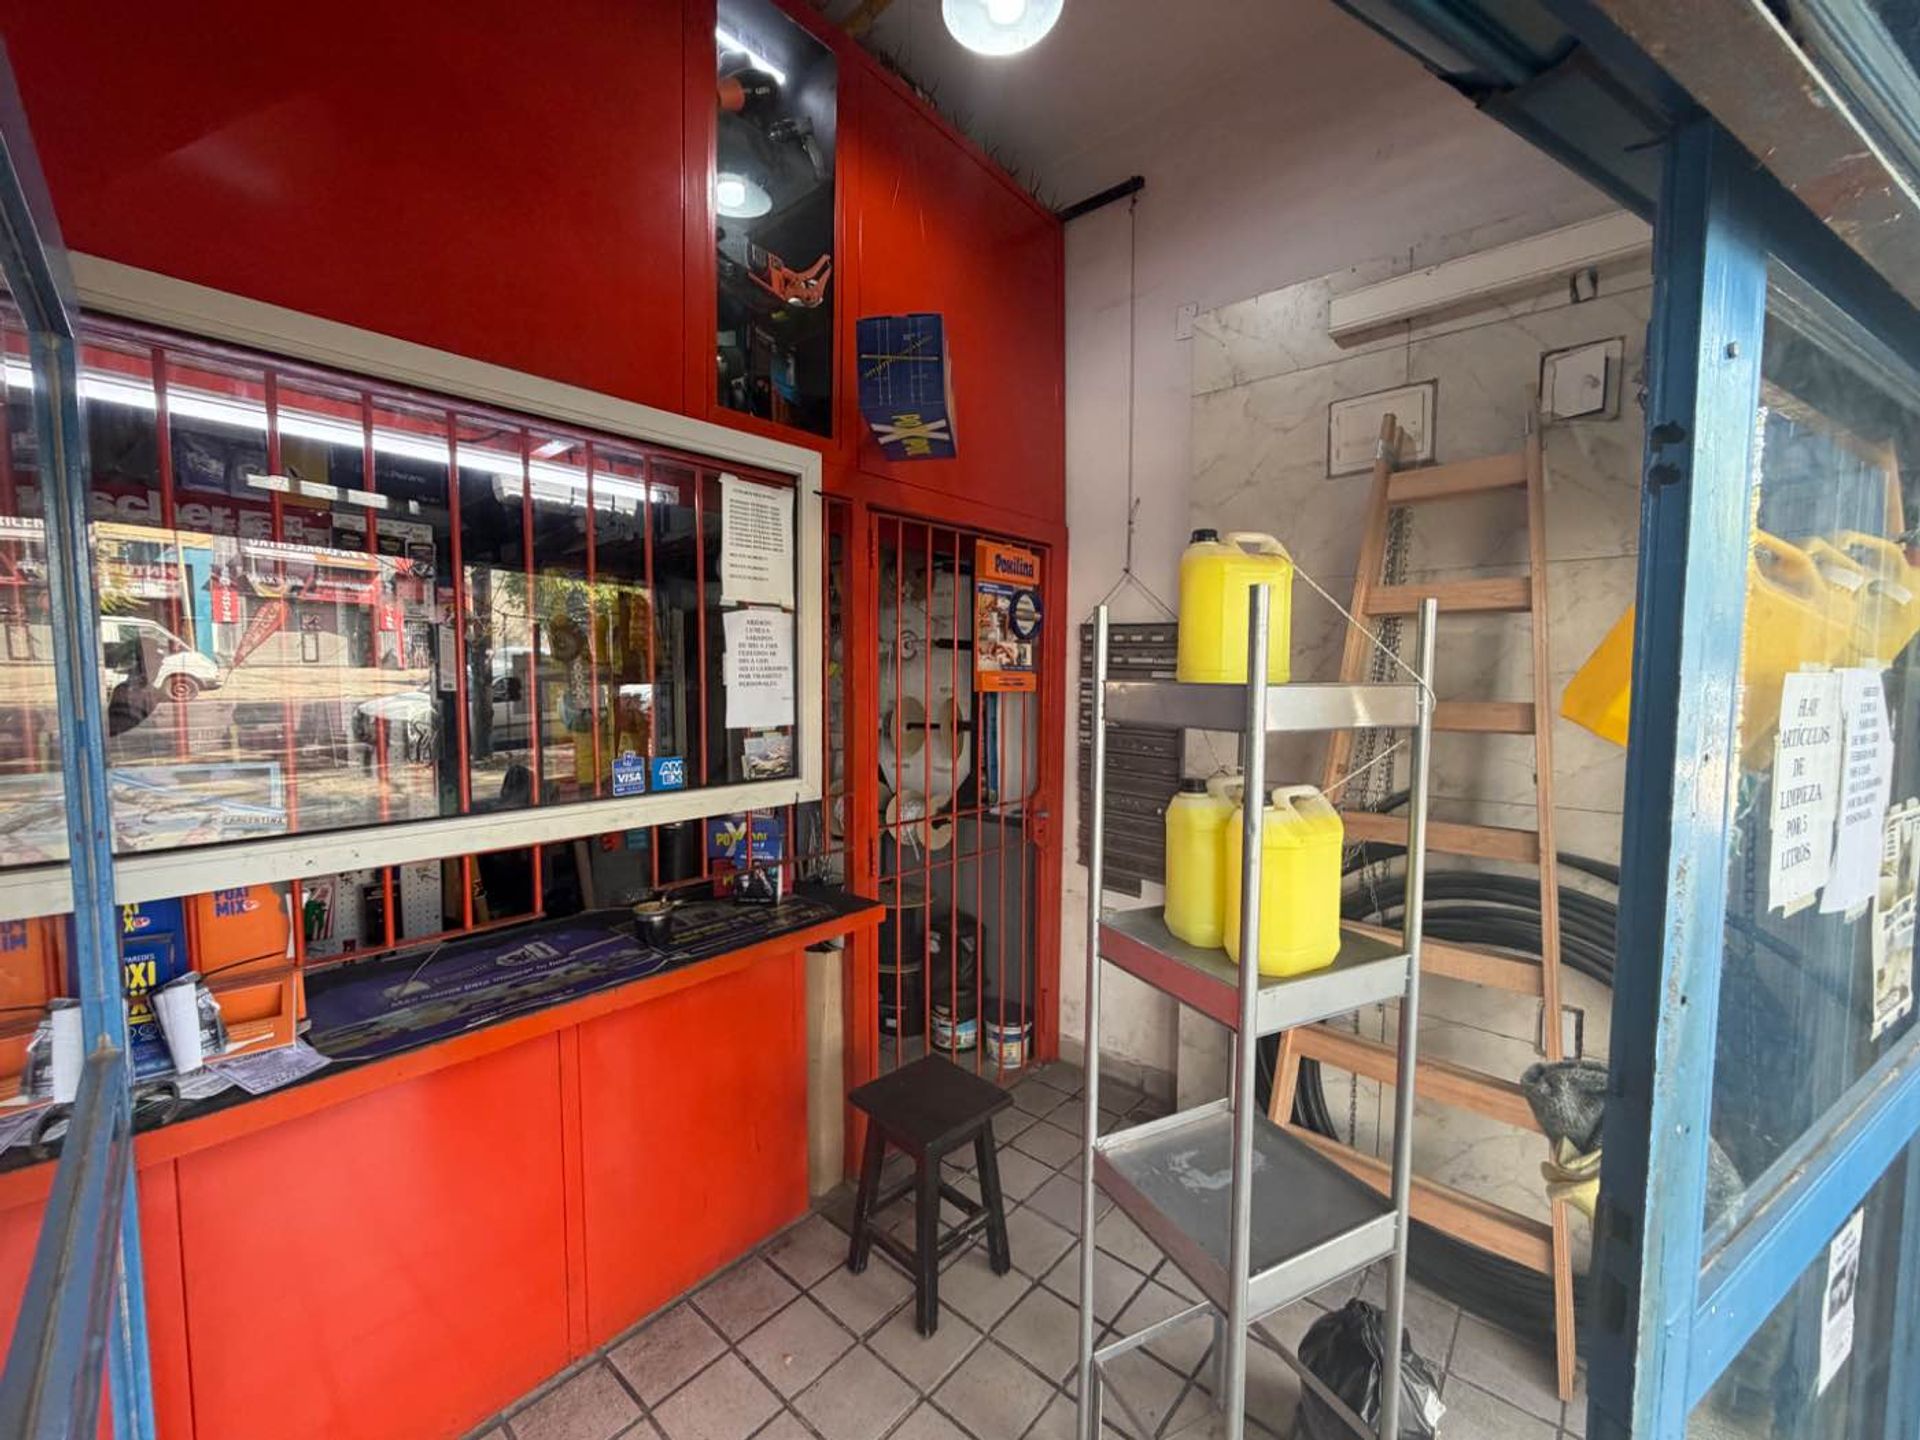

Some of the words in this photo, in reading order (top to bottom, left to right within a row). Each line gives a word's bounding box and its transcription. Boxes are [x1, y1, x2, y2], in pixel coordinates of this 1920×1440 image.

[1798, 698, 1819, 717] HAY
[1782, 722, 1830, 748] ARTÍCULOS
[617, 771, 642, 783] VISA
[1793, 757, 1805, 777] DE
[1786, 816, 1802, 838] POR
[1781, 845, 1811, 870] LITROS
